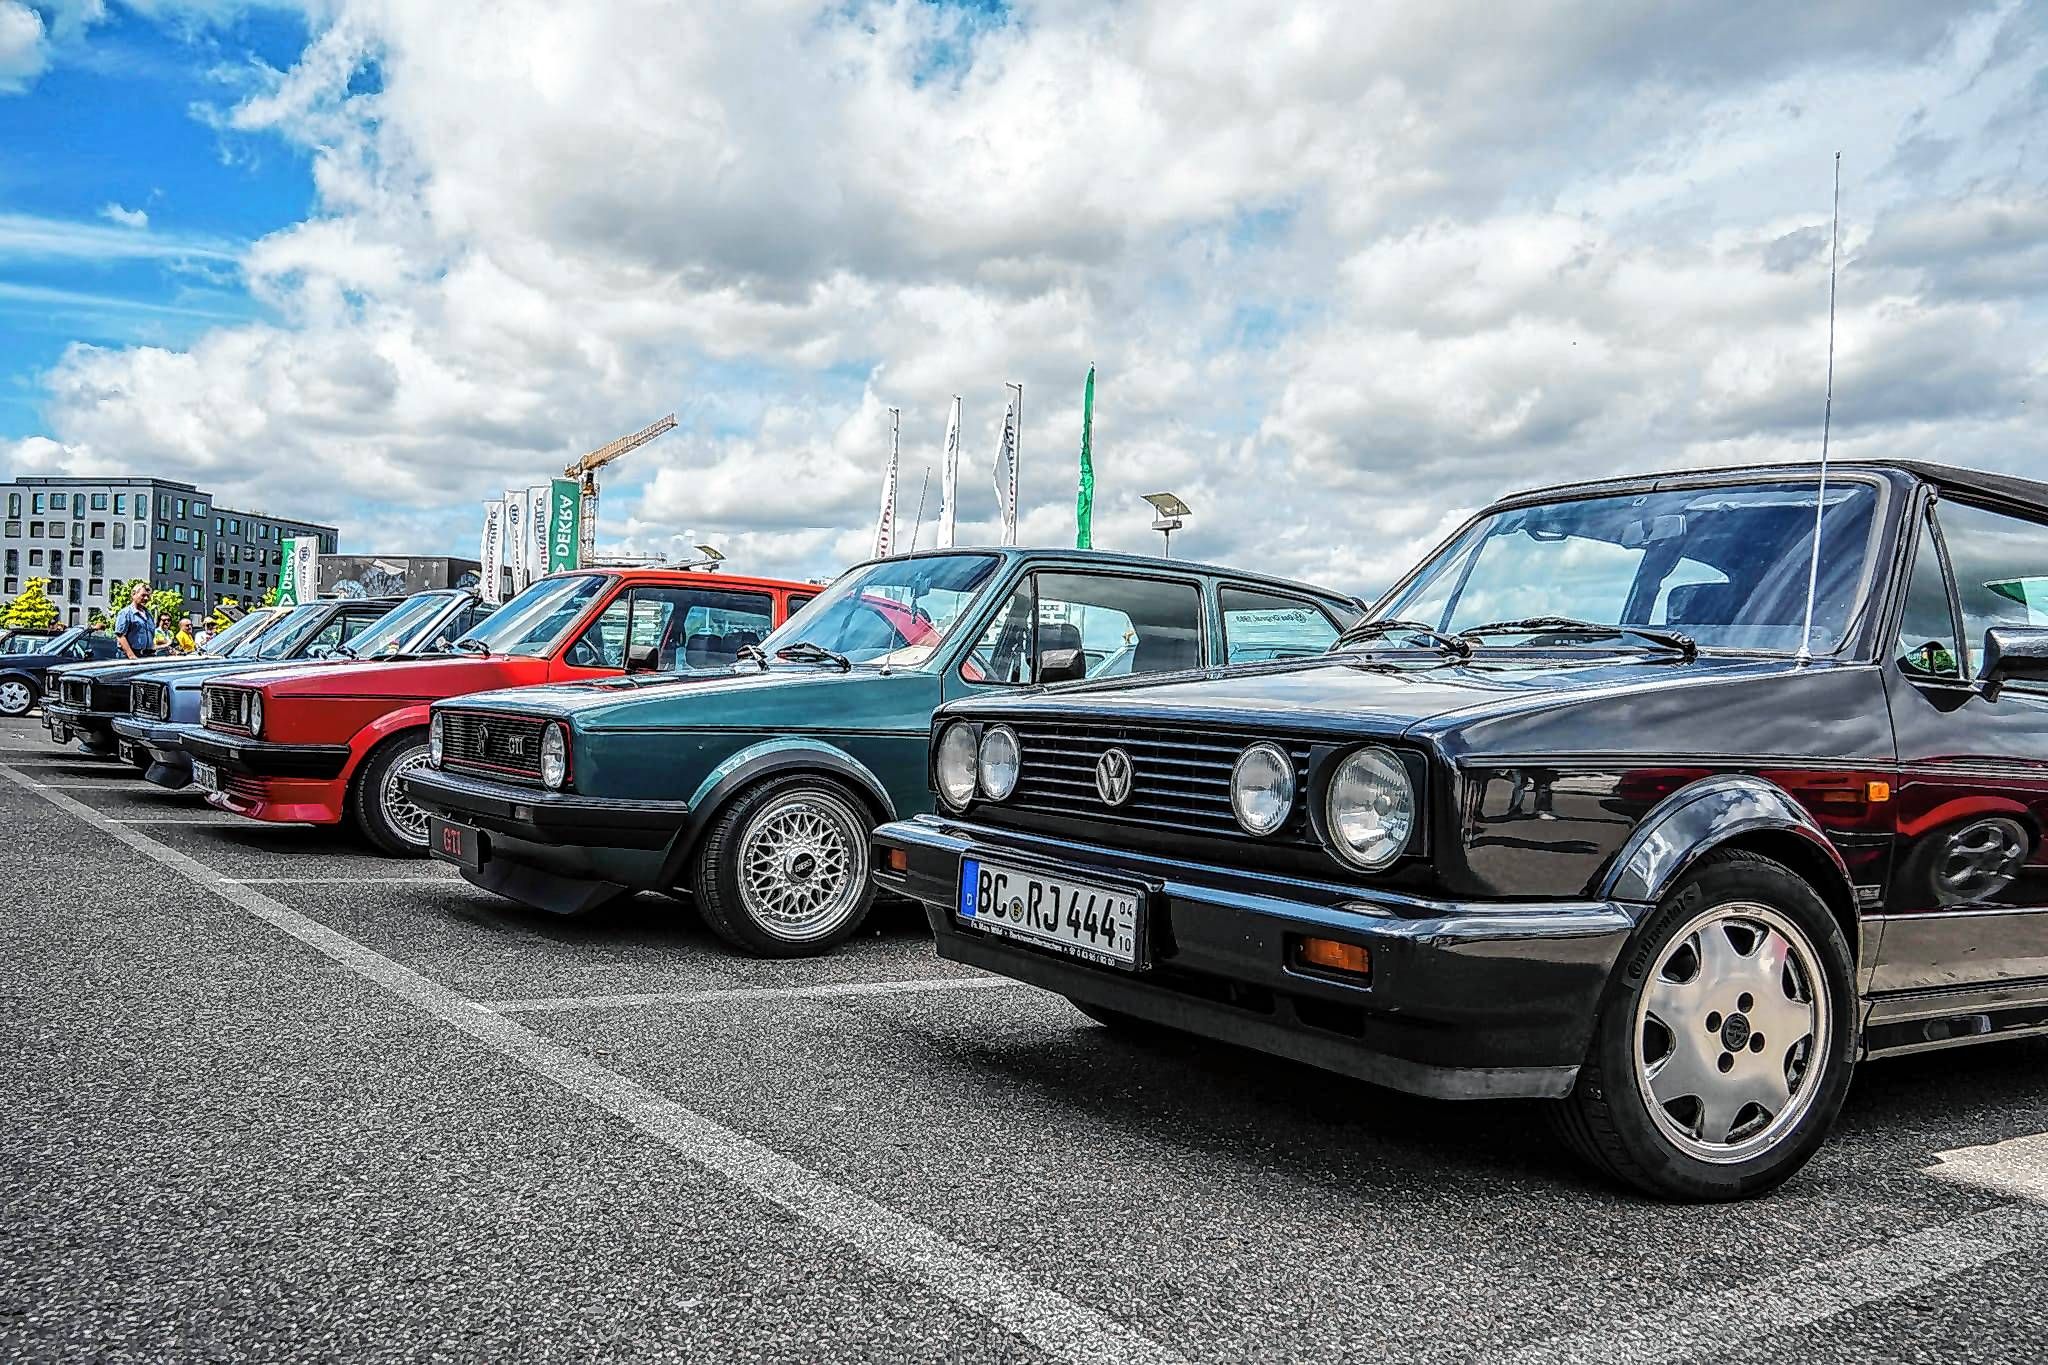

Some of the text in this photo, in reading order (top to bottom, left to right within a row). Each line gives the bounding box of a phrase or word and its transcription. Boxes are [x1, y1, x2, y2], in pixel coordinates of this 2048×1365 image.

[508, 735, 524, 755] GTI
[442, 827, 462, 856] GTI
[977, 869, 1008, 918] BC
[1026, 881, 1061, 932] RJ
[1067, 890, 1116, 948] 444
[1119, 936, 1131, 952] 10
